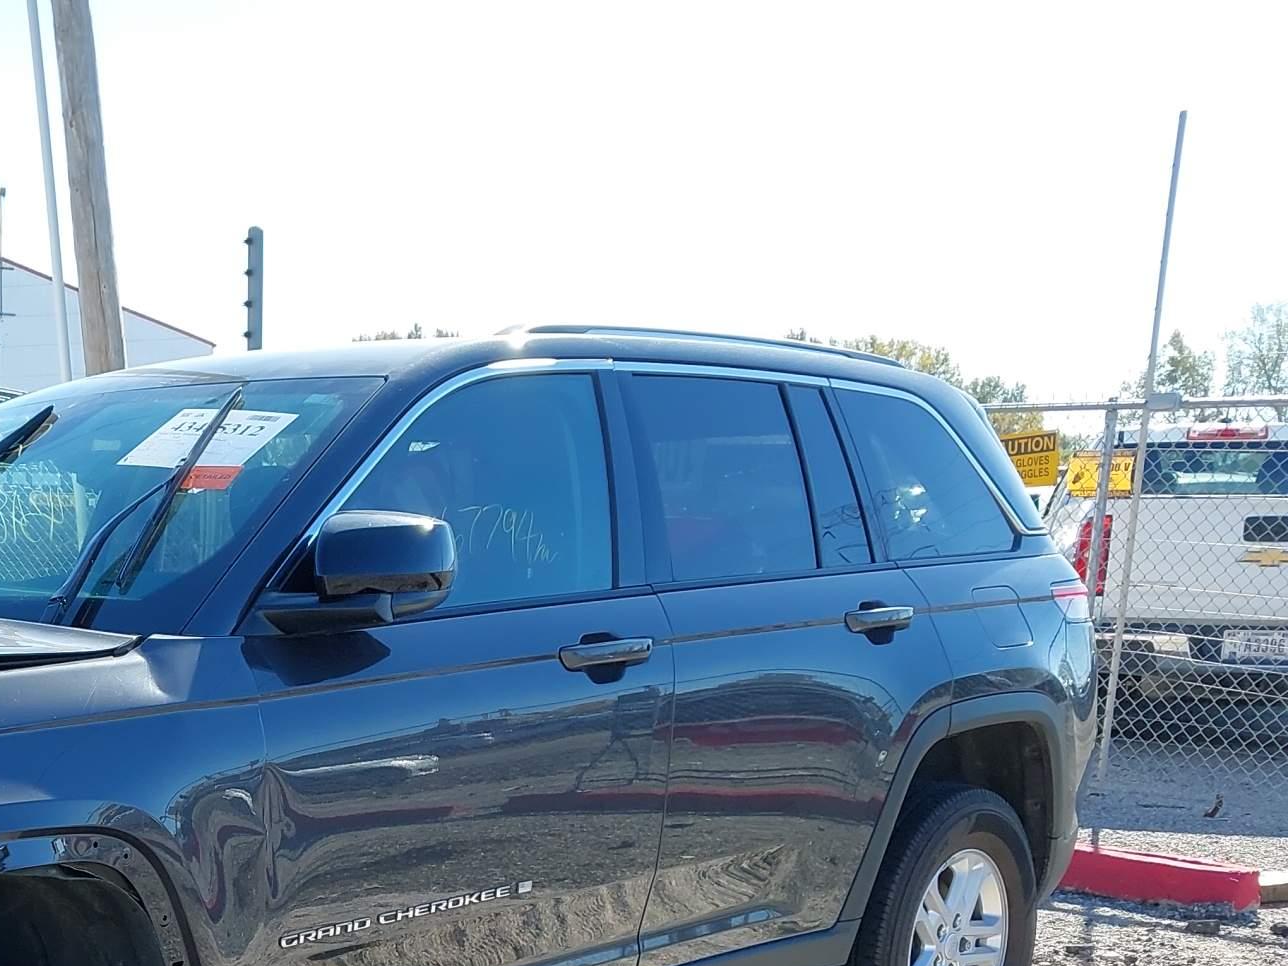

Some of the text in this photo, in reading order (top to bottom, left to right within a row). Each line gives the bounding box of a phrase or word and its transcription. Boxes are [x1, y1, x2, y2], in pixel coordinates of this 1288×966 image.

[171, 421, 266, 437] 4345312
[1015, 455, 1050, 468] GLOVES
[1018, 467, 1050, 480] GGLES
[280, 884, 511, 949] GRAND CHEROKEE
